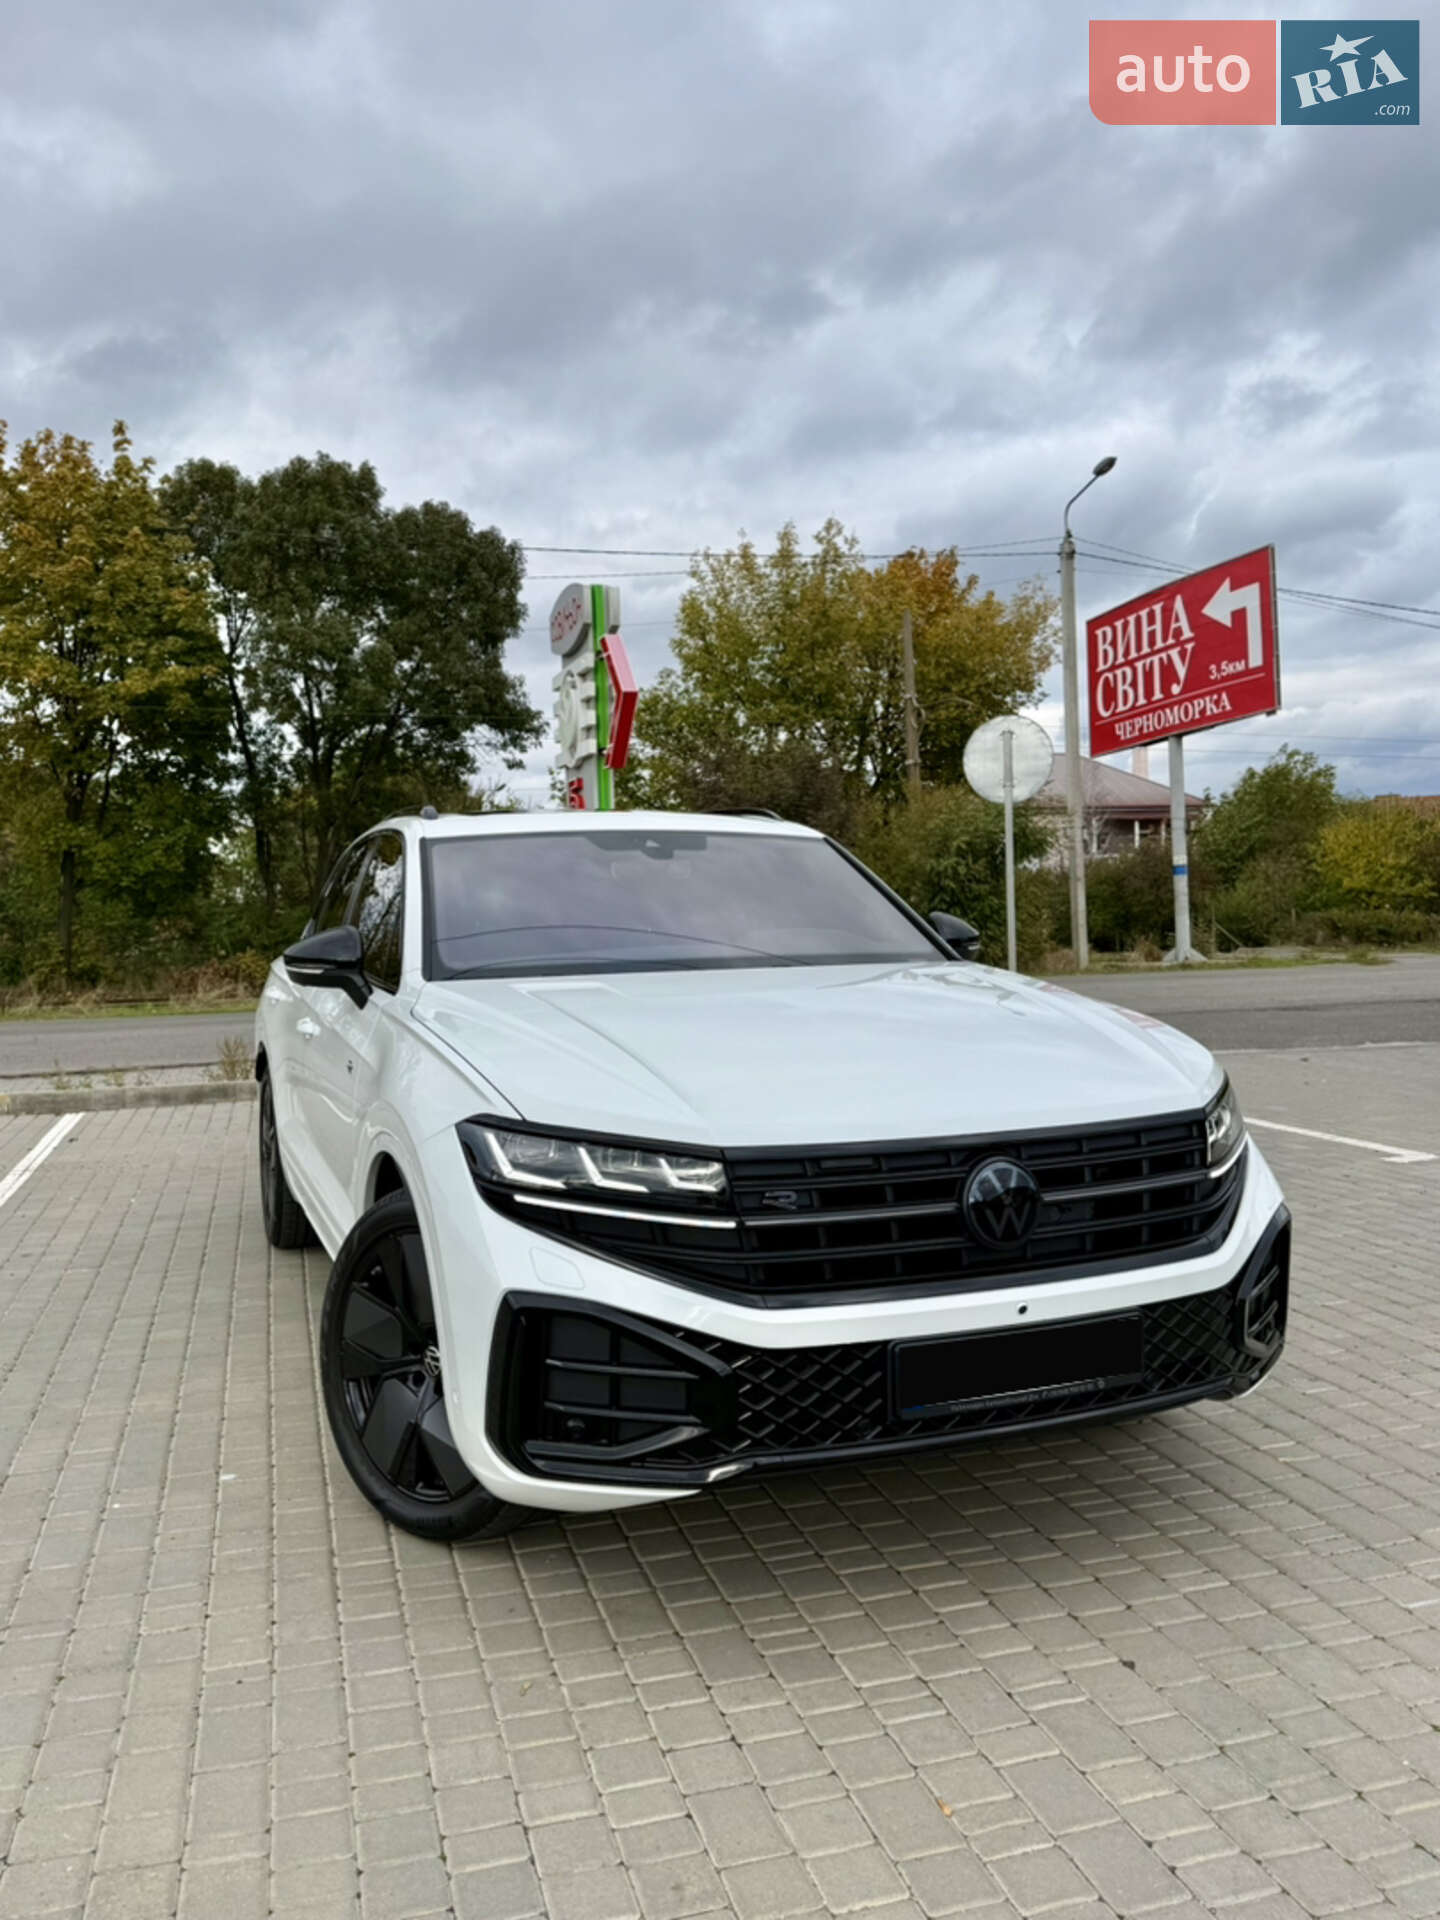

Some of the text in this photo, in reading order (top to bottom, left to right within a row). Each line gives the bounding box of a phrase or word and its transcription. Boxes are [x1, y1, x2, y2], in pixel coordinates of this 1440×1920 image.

[1095, 594, 1195, 672] ВИНА
[1096, 642, 1195, 718] СВІТУ
[1208, 660, 1246, 680] 3,5км
[1115, 691, 1232, 740] ЧЕРНОМОРКА
